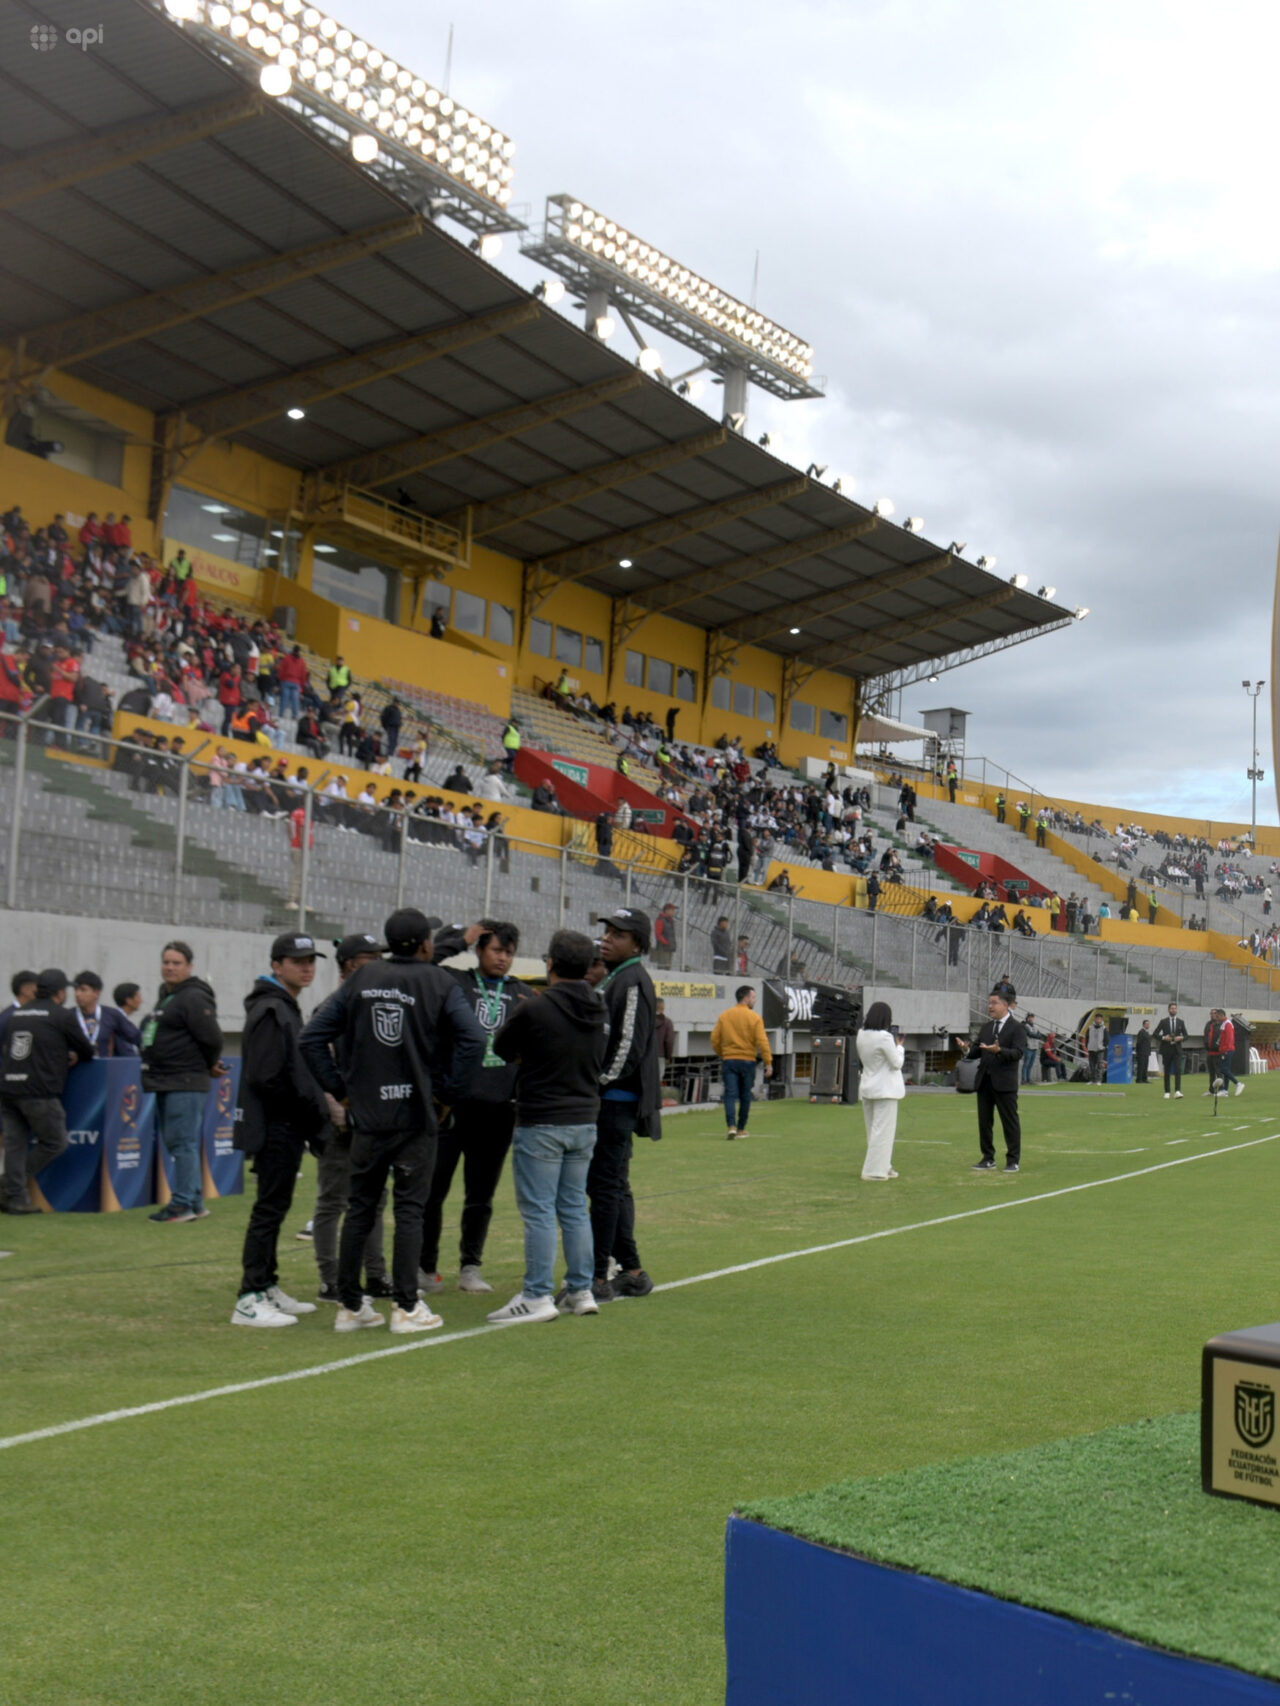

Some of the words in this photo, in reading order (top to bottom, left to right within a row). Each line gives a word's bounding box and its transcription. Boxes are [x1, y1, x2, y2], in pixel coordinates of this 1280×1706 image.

[361, 987, 416, 1006] marathon
[380, 1084, 413, 1100] STAFF
[1231, 1447, 1277, 1466] FEDERACIÓN
[1228, 1458, 1280, 1478] ECUATORIANA
[1234, 1470, 1244, 1480] DE
[1245, 1472, 1274, 1488] FÚTBOL
